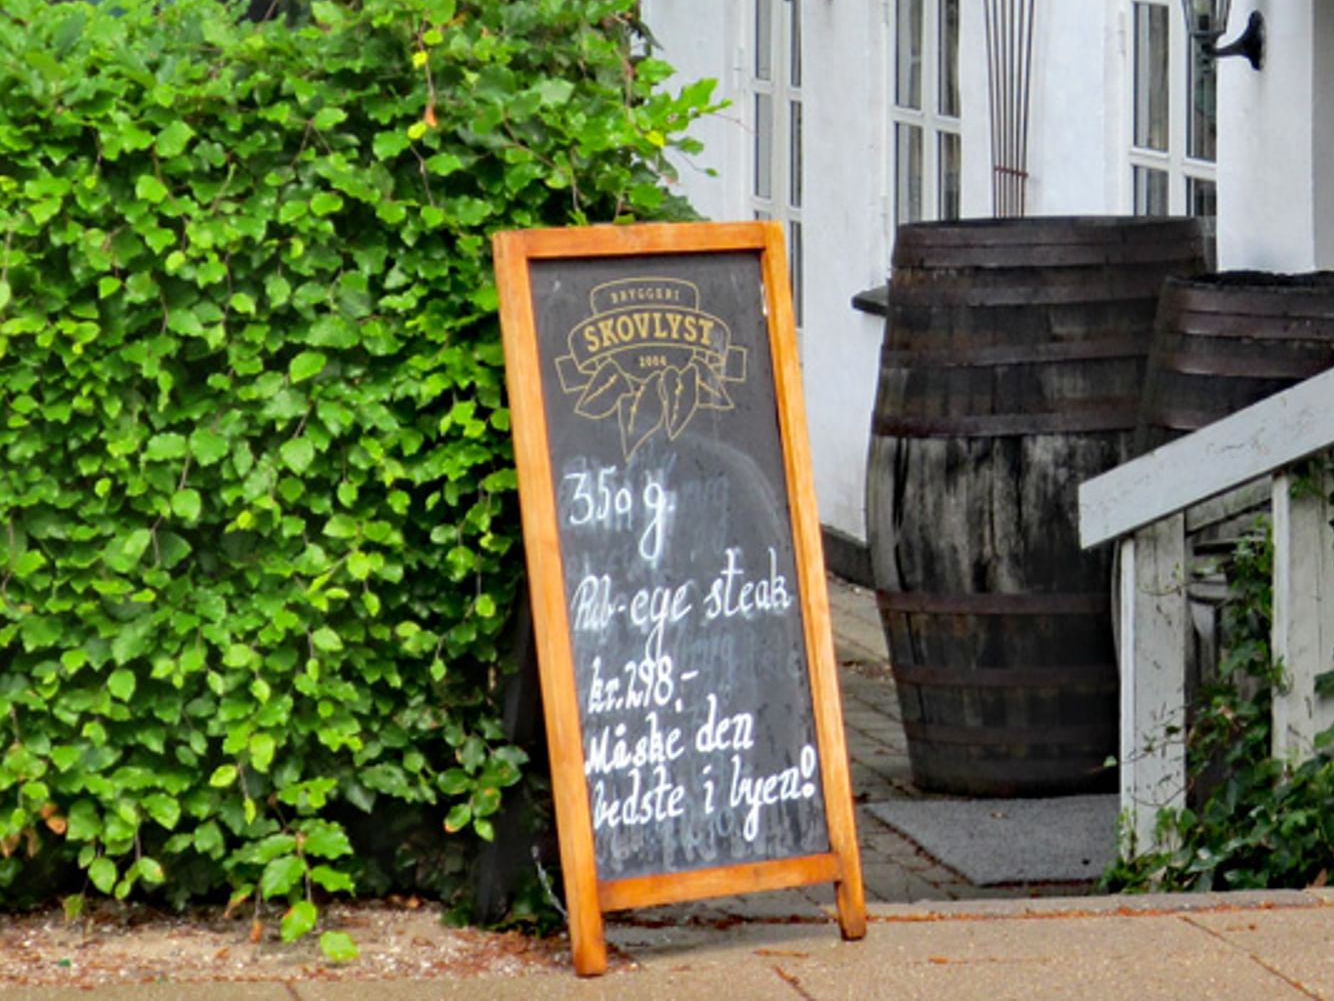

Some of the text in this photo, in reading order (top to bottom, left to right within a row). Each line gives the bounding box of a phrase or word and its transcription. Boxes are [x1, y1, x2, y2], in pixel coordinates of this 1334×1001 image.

[583, 312, 714, 352] SKOVLYST
[703, 548, 793, 619] steak
[584, 693, 755, 776] Måske den
[593, 744, 816, 843] bedste i byen!
